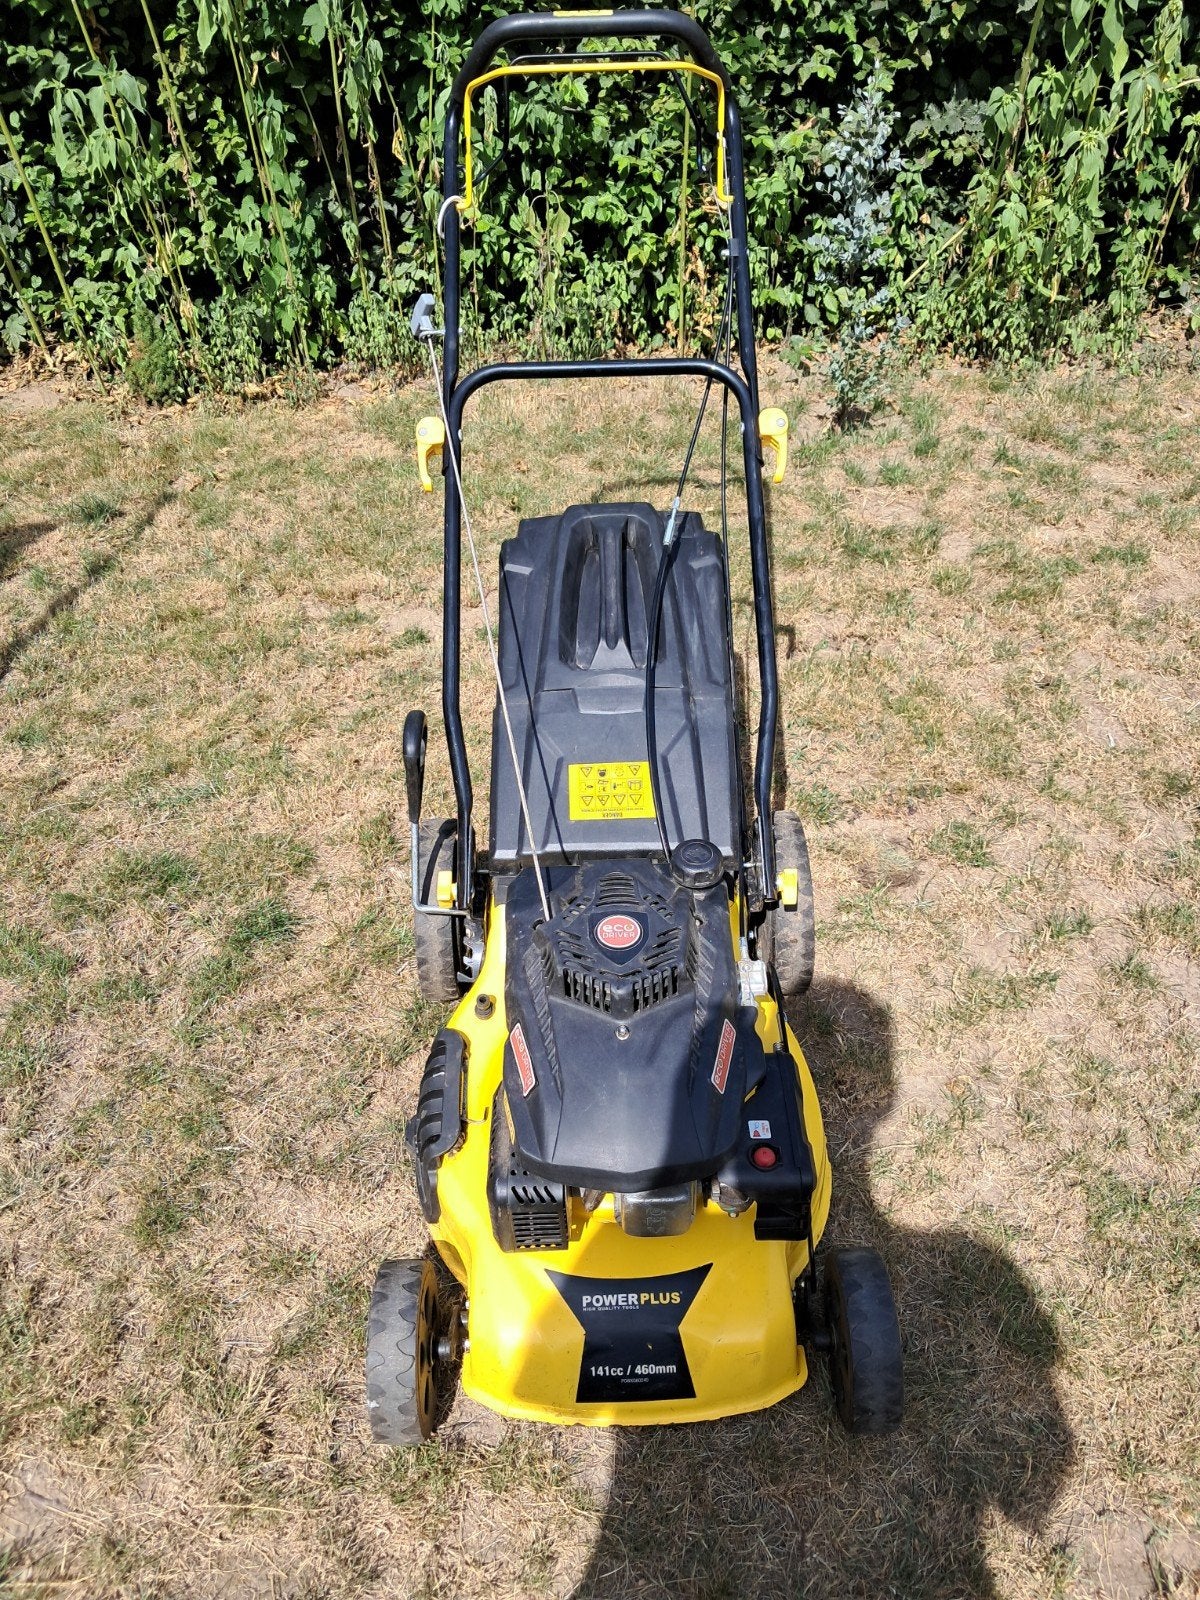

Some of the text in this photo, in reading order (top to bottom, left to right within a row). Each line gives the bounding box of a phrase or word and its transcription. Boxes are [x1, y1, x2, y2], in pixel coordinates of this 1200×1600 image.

[602, 924, 635, 932] eco
[602, 931, 635, 939] DRIVER
[714, 1058, 724, 1085] eco
[720, 1023, 732, 1059] DRIVER
[582, 1292, 681, 1307] POWERPLUS
[590, 1364, 676, 1376] 141cc / 460mm
